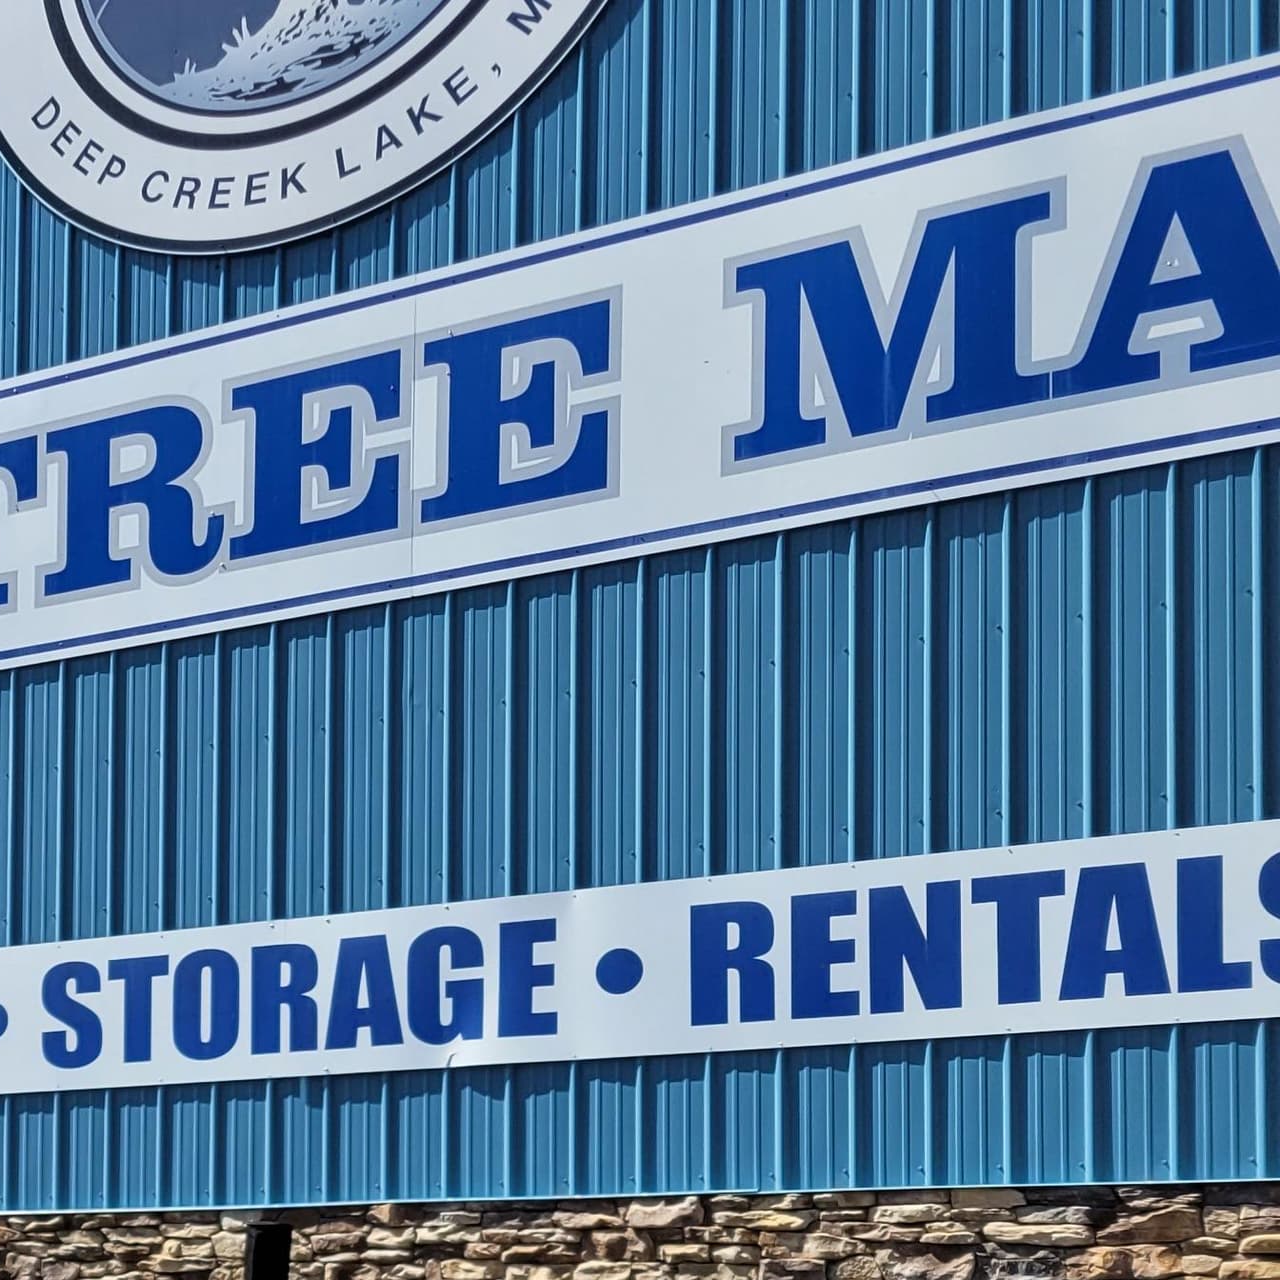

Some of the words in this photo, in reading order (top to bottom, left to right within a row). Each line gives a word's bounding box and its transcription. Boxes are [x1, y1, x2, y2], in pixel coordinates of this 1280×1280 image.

[30, 96, 128, 187] DEEP
[139, 160, 309, 211] CREEK
[334, 62, 502, 179] LAKE,
[733, 148, 1280, 463] MA
[41, 918, 558, 1070] STORAGE
